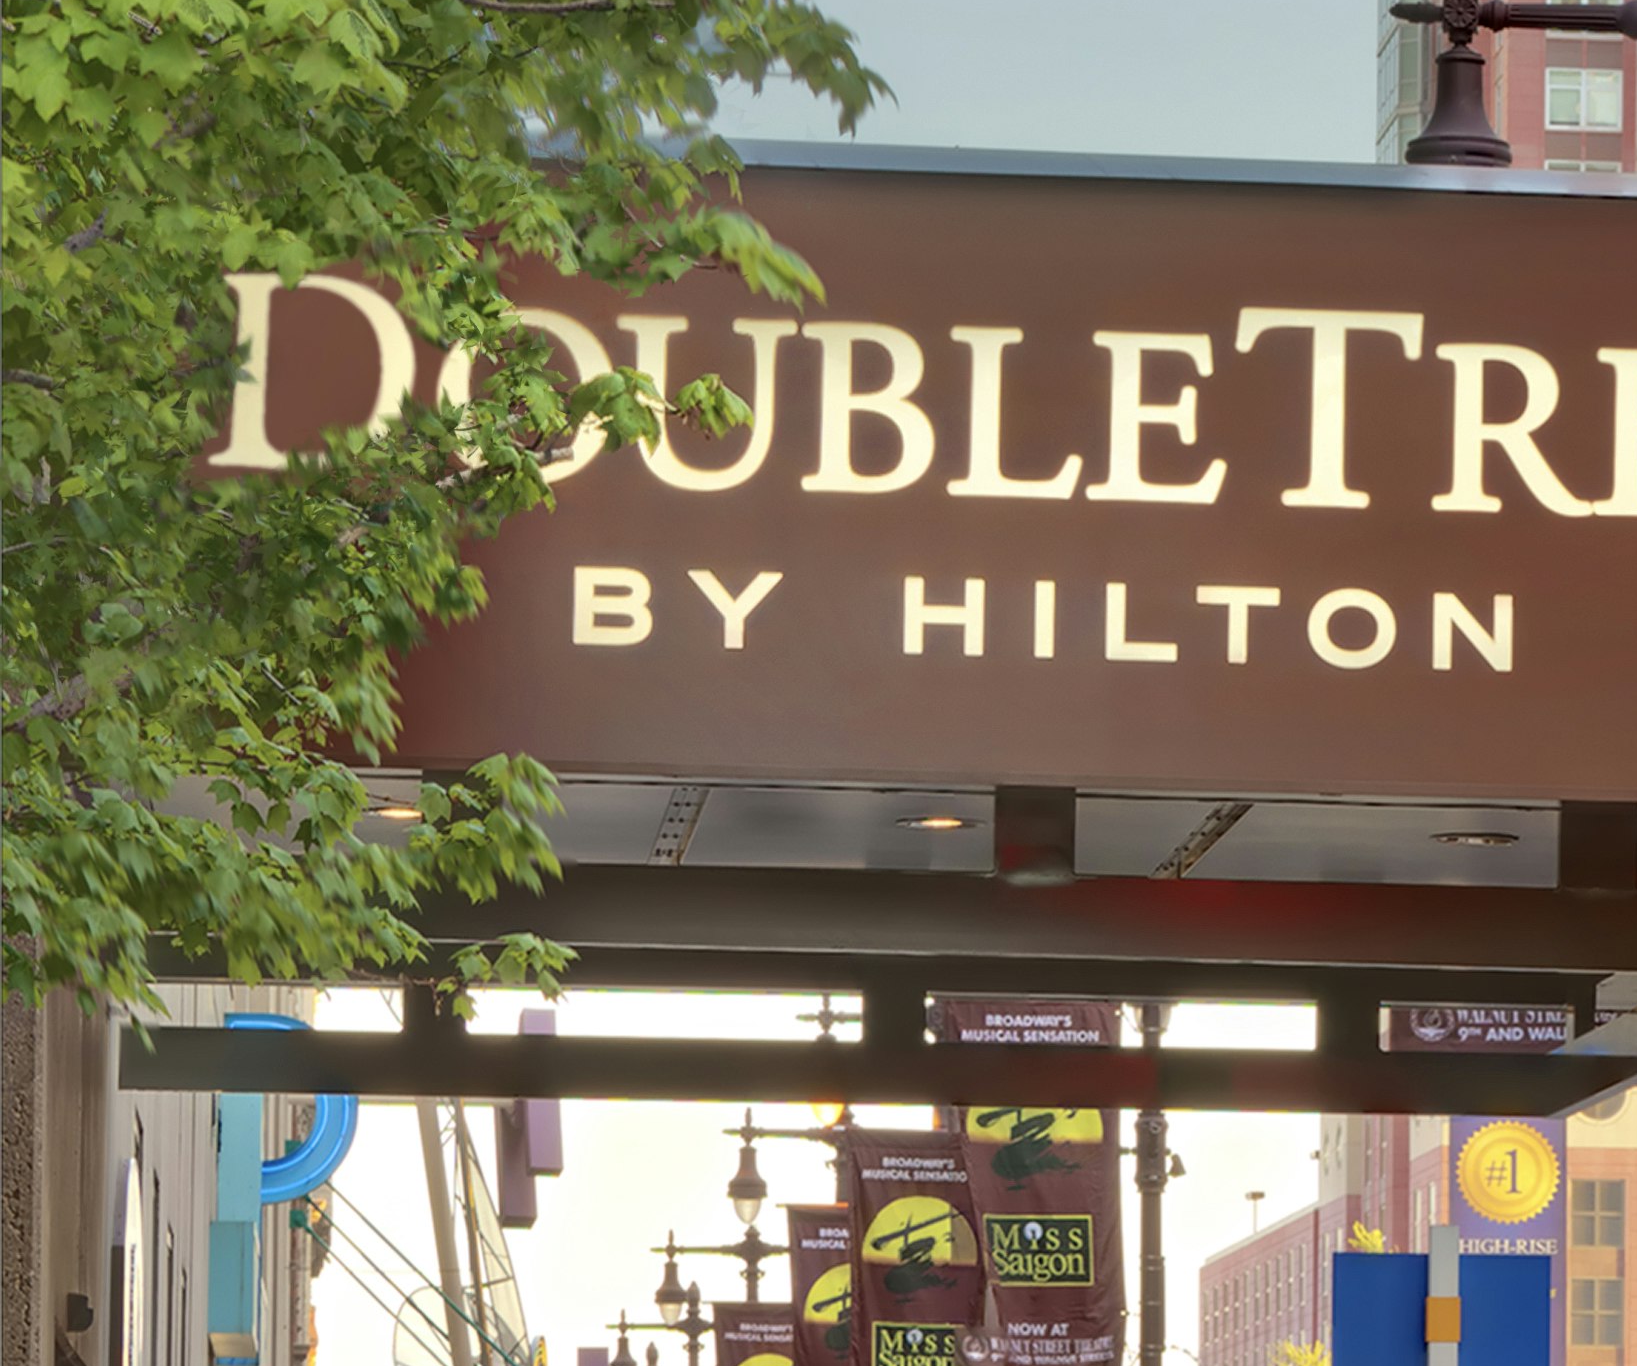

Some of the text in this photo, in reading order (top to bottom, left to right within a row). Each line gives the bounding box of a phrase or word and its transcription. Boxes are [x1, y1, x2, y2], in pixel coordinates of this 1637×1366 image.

[573, 566, 1515, 674] BY HILTON
[985, 1014, 1072, 1027] BROADWAY'S
[961, 1030, 1099, 1043] MUSICAL SENSATION
[1486, 1028, 1524, 1041] AND
[1528, 1028, 1567, 1041] WAL
[862, 1169, 968, 1182] MUSICAL SENSATIO
[1485, 1149, 1522, 1195] #1
[1459, 1238, 1558, 1255] HIGH-RISE
[993, 1249, 1085, 1281] Saigon
[1008, 1323, 1069, 1335] NOW AT
